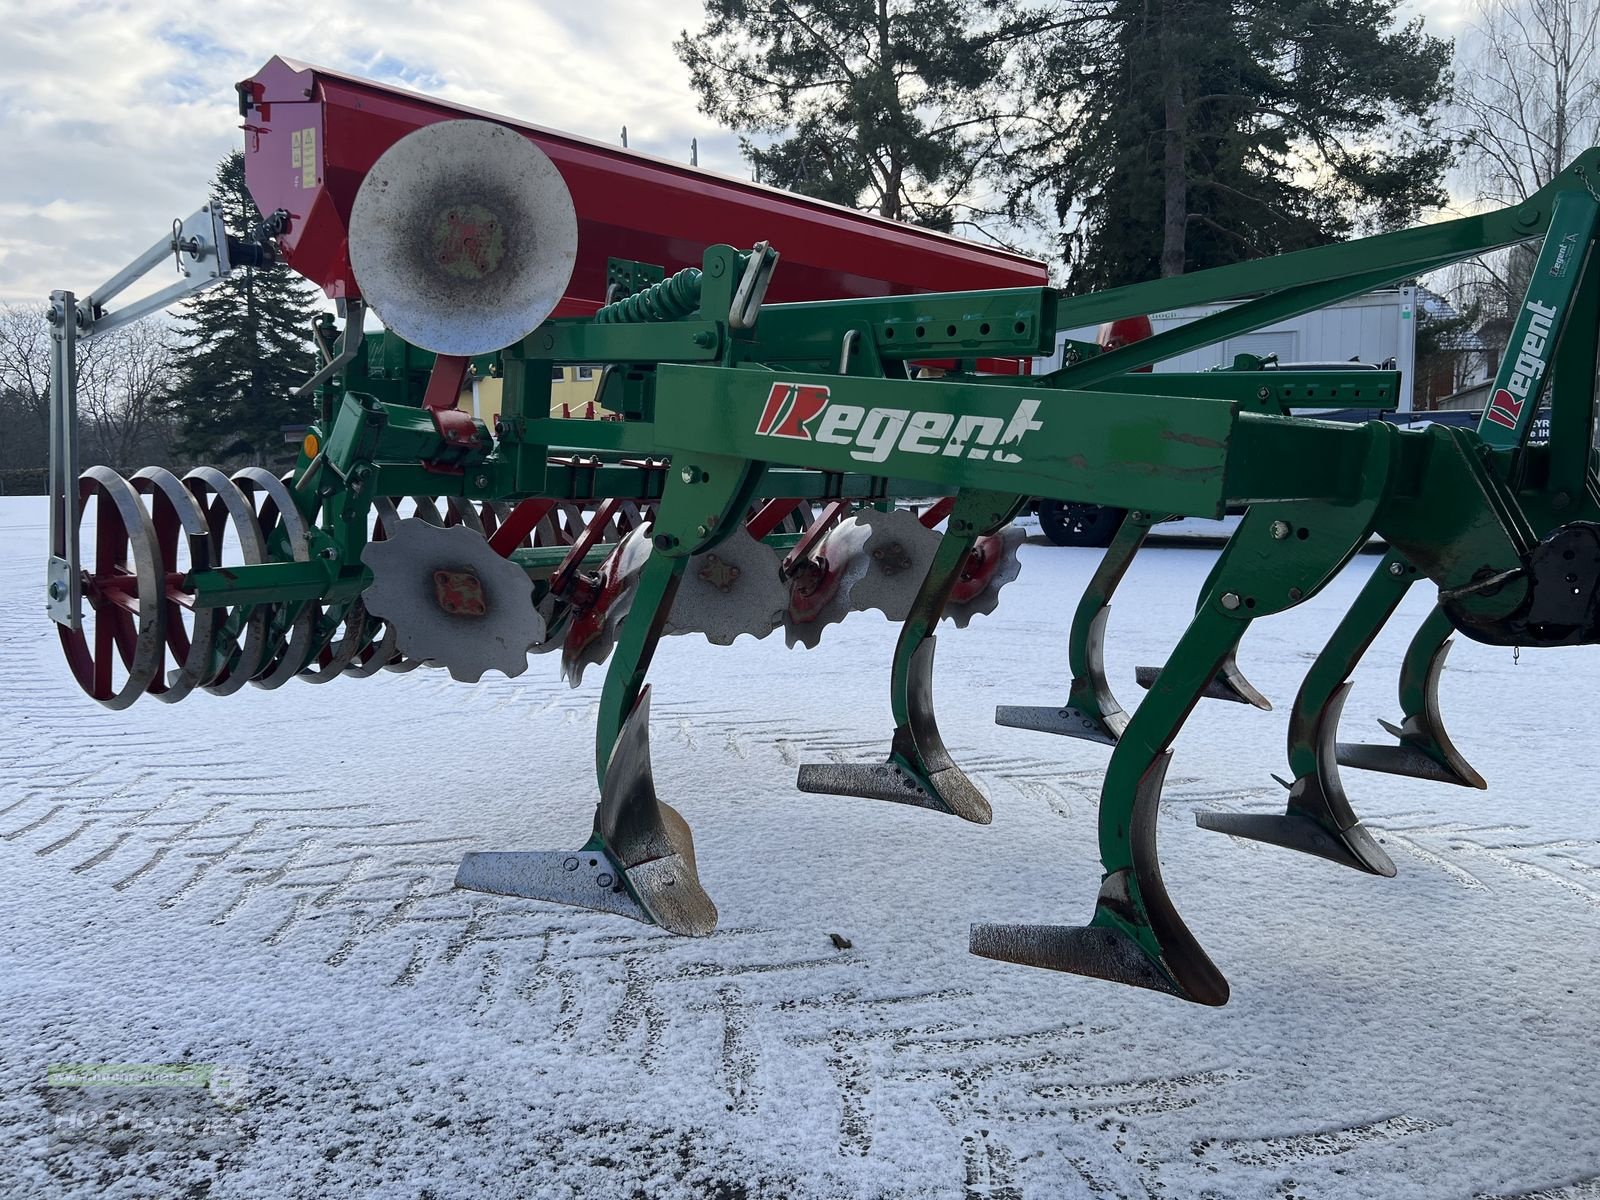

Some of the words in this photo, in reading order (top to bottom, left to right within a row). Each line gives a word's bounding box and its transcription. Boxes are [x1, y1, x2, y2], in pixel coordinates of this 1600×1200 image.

[1549, 243, 1568, 278] Regent
[1486, 300, 1558, 430] Regent
[755, 381, 1044, 463] Regent
